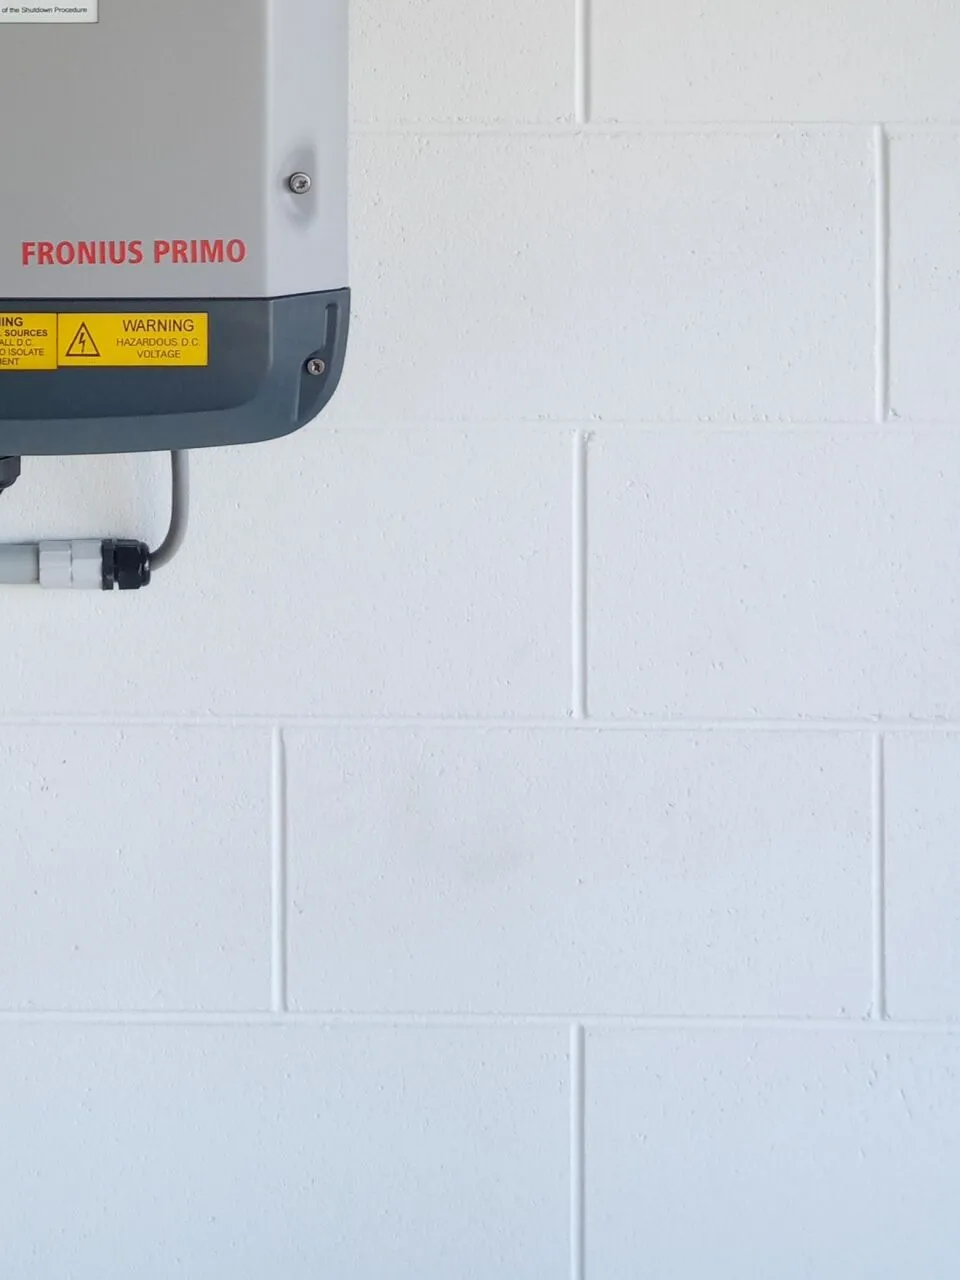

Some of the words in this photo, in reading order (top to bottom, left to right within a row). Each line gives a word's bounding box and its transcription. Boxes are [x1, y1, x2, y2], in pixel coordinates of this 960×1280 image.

[21, 239, 143, 266] FRONIUS
[153, 238, 246, 264] PRIMO
[122, 319, 195, 332] WARNING
[4, 329, 48, 337] SOURCES
[0, 338, 14, 346] ALL
[16, 338, 33, 346] D.C.
[116, 338, 178, 347] HAZARDOUS
[181, 338, 200, 347] D.C.
[8, 348, 45, 356] ISOLATE
[136, 350, 181, 359] VOLTAGE
